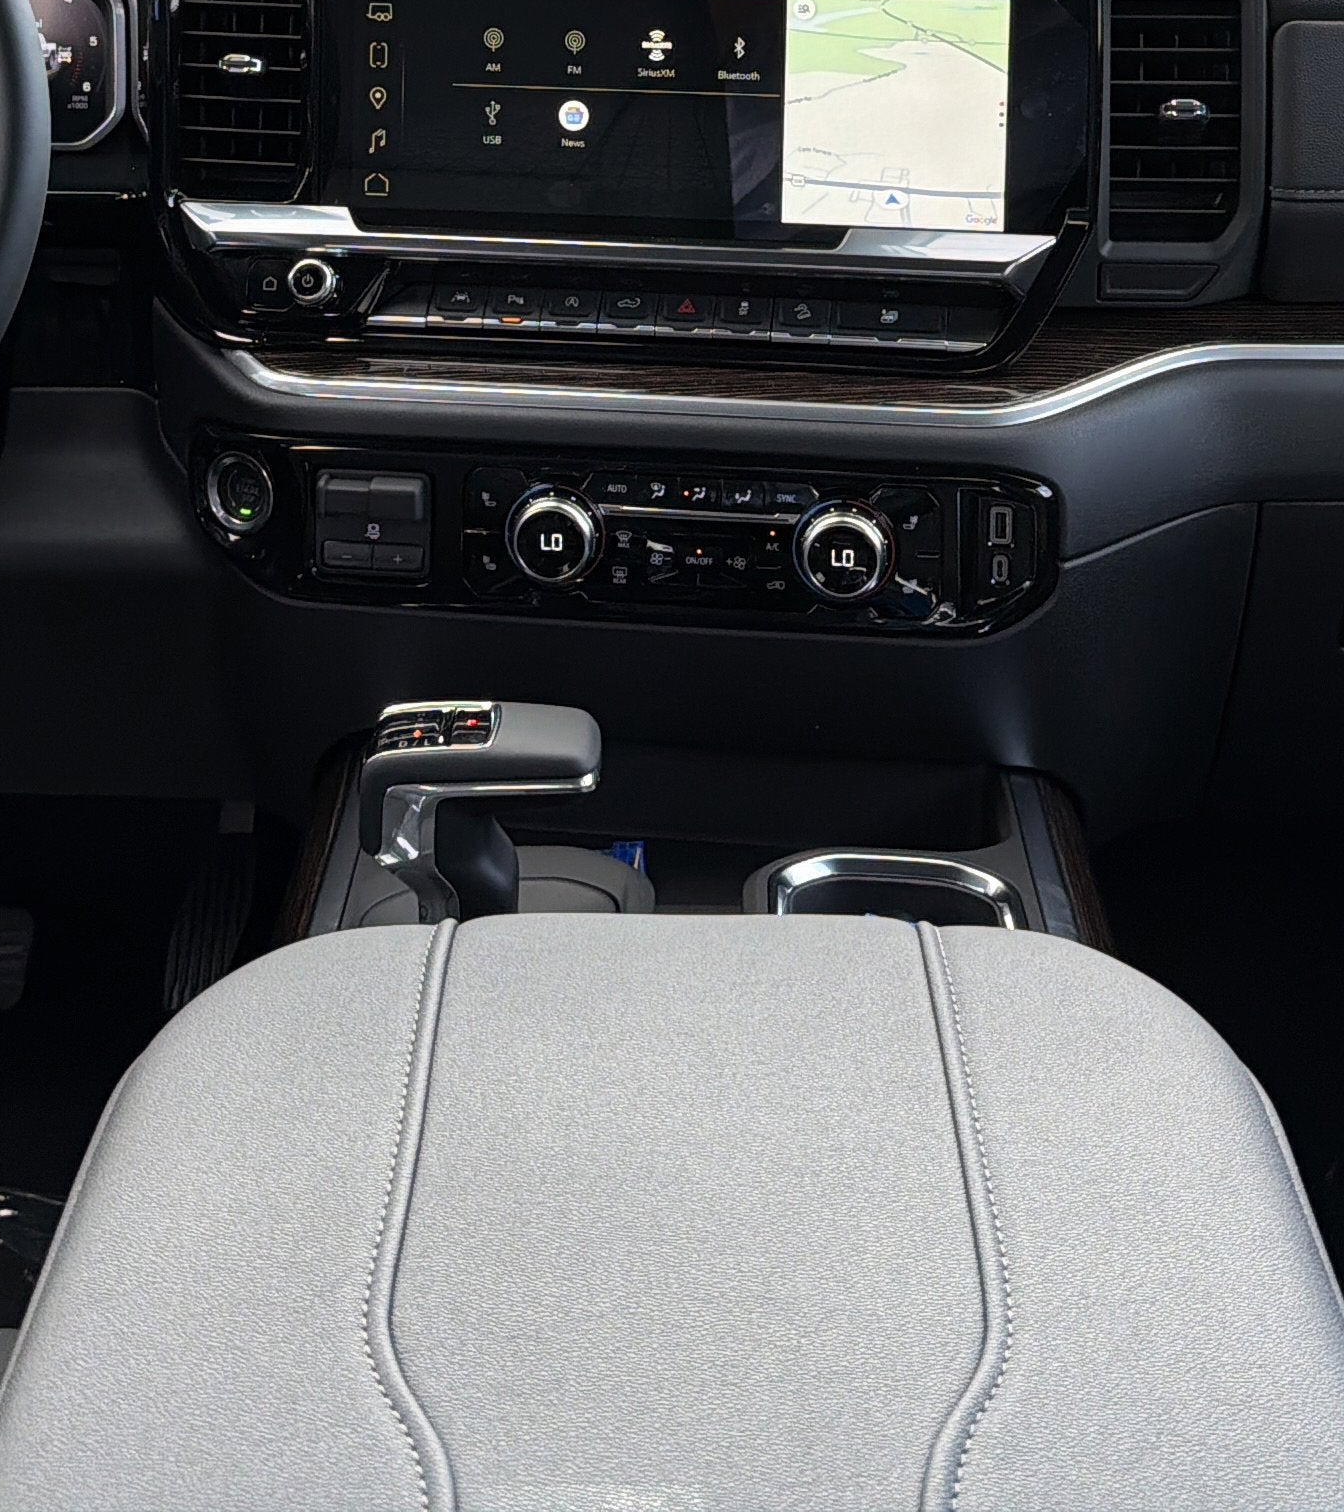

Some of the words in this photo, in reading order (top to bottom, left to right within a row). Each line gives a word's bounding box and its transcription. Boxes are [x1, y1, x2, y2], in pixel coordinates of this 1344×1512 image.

[89, 36, 98, 47] 5
[485, 62, 501, 72] AM
[567, 65, 582, 75] FM
[637, 68, 676, 78] SiriusXM
[717, 70, 761, 81] Bluetooth
[82, 81, 92, 92] 6
[483, 135, 502, 145] USB
[561, 138, 585, 148] News
[965, 214, 998, 226] Google
[607, 485, 627, 493] AUTO
[776, 494, 797, 503] SYNC
[540, 533, 563, 551] LO
[766, 542, 780, 551] A/C
[685, 557, 713, 566] ON/OFF
[831, 549, 854, 567] LO
